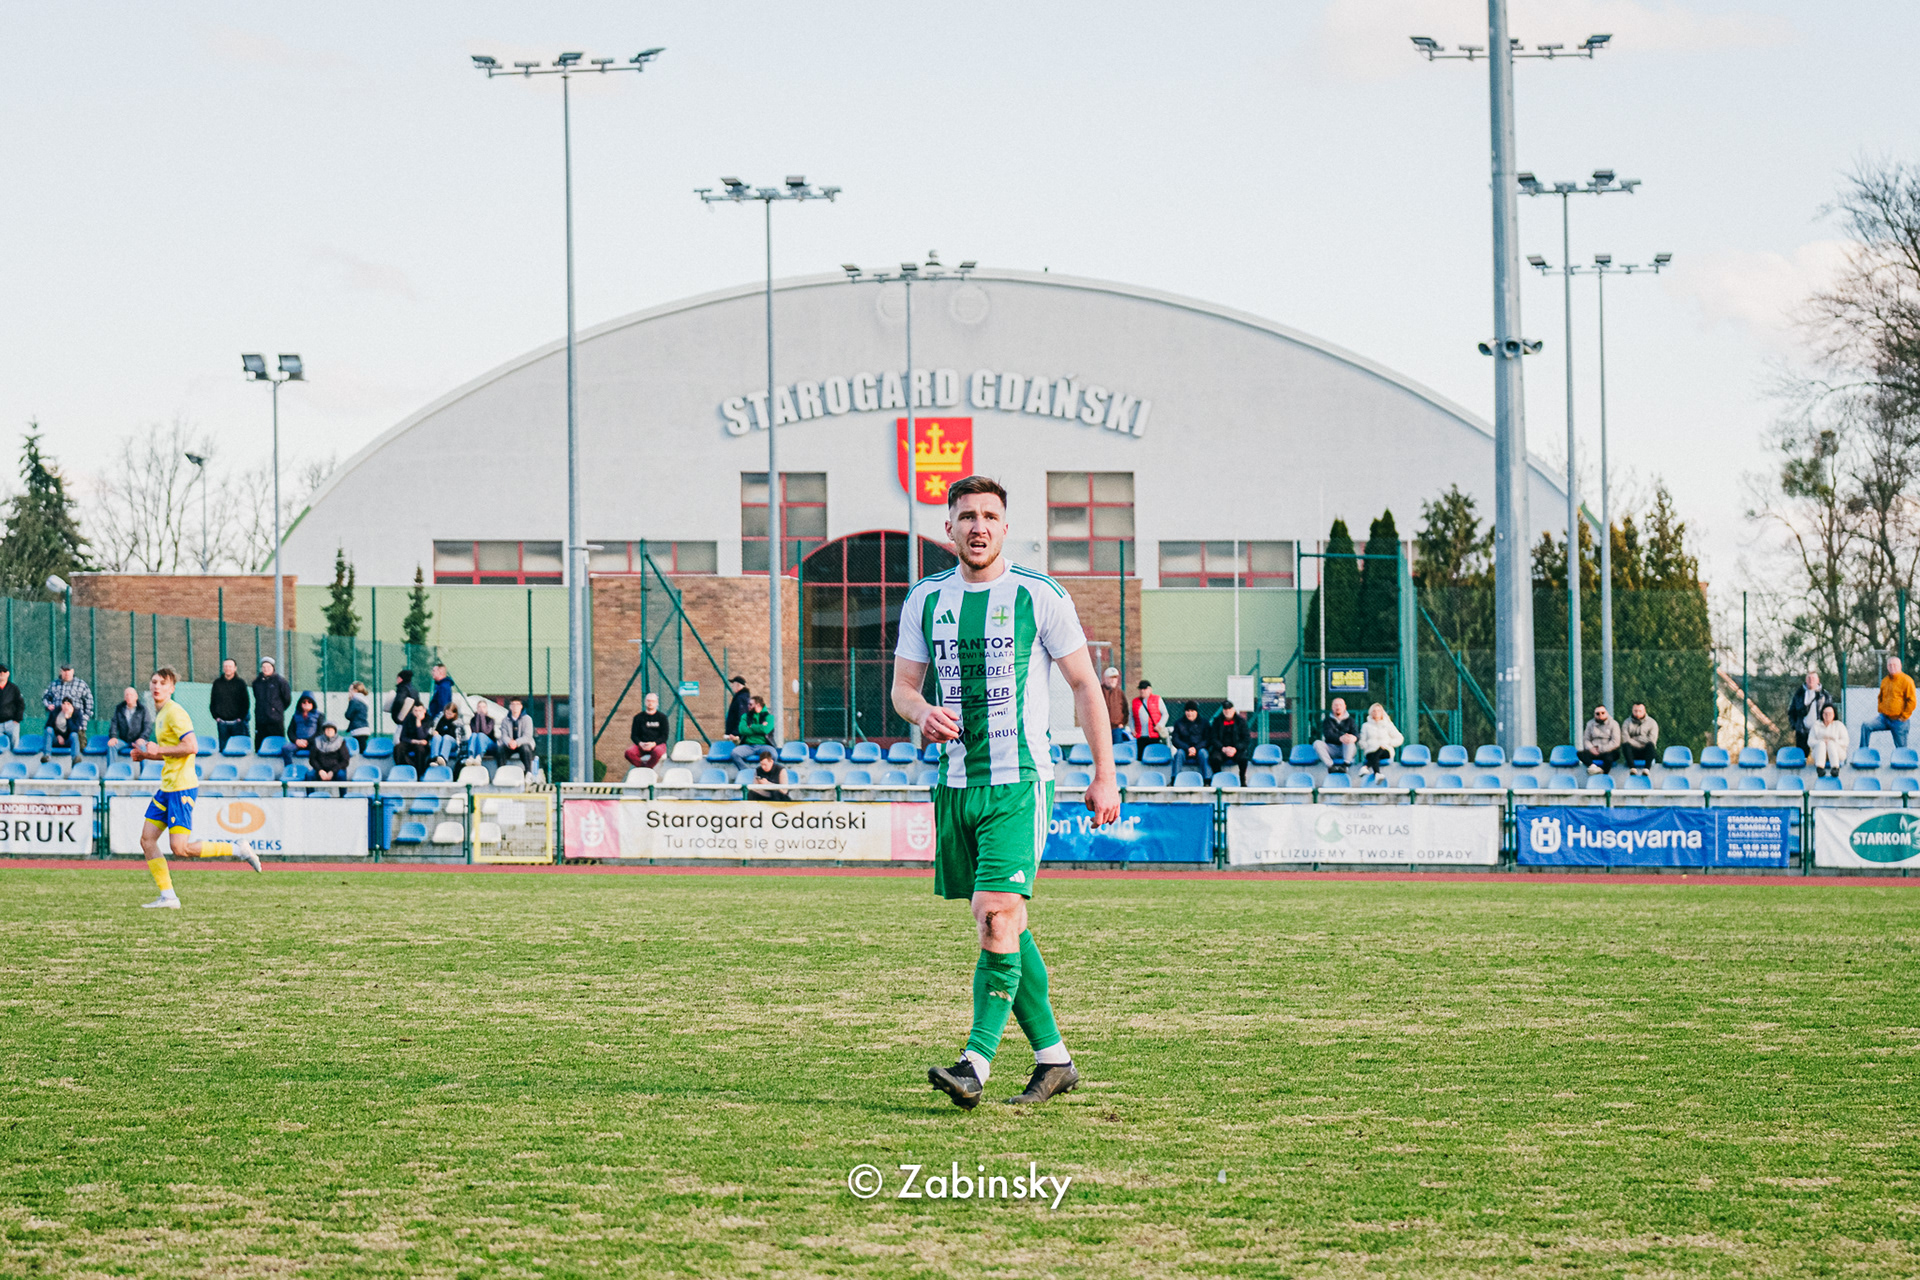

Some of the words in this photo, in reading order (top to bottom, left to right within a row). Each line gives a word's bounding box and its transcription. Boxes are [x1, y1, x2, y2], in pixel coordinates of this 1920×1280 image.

[722, 368, 960, 436] STAROGARD
[970, 368, 1152, 438] GDAŃSKI
[949, 637, 1014, 650] PANTOR
[646, 810, 762, 833] Starogard
[771, 811, 866, 830] Gdański
[1346, 824, 1384, 835] STARY
[1388, 824, 1410, 836] LAS
[664, 835, 683, 848] Tu
[689, 835, 738, 853] rodzą
[744, 836, 769, 853] się
[775, 837, 847, 853] gwiazdy
[1567, 824, 1702, 853] Husqvarna
[1853, 832, 1911, 845] STARKOM
[1254, 849, 1346, 859] UTYLIZUJEMY
[1358, 849, 1405, 859] TWOJE
[1417, 850, 1473, 859] ODPADY
